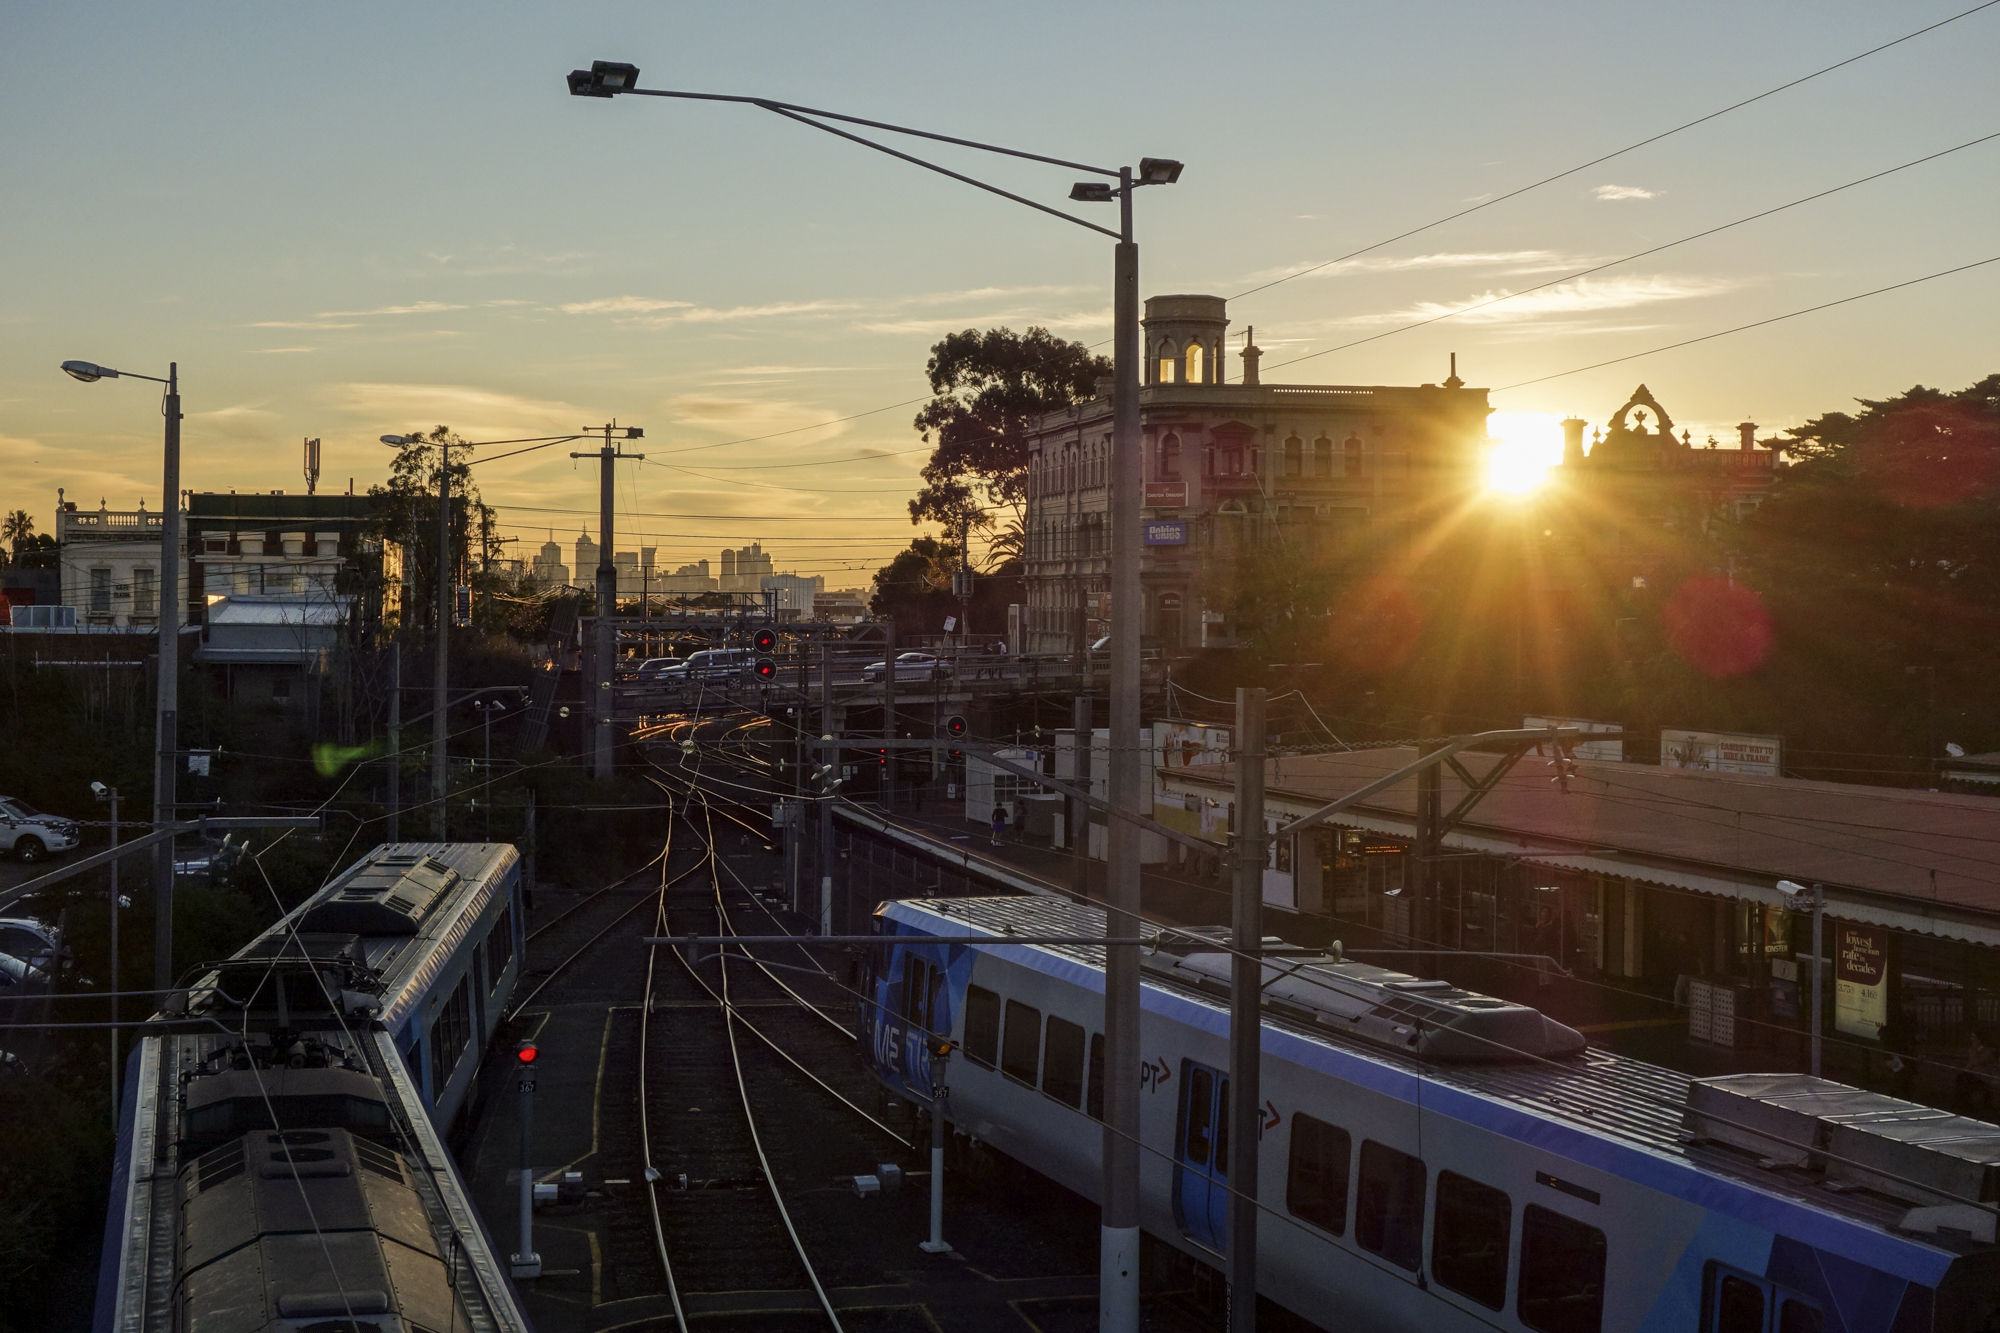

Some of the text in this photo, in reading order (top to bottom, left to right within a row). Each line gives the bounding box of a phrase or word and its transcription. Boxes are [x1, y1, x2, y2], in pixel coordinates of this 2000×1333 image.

[1149, 525, 1181, 540] Pokies
[1720, 742, 1774, 755] EASIEST WAY TO
[1723, 751, 1738, 760] HIRE
[1745, 754, 1771, 763] TRADIE
[1846, 931, 1873, 948] lowest
[1842, 949, 1859, 961] rate
[1846, 960, 1877, 975] decades
[519, 1084, 534, 1093] 367
[934, 1090, 948, 1098] 357
